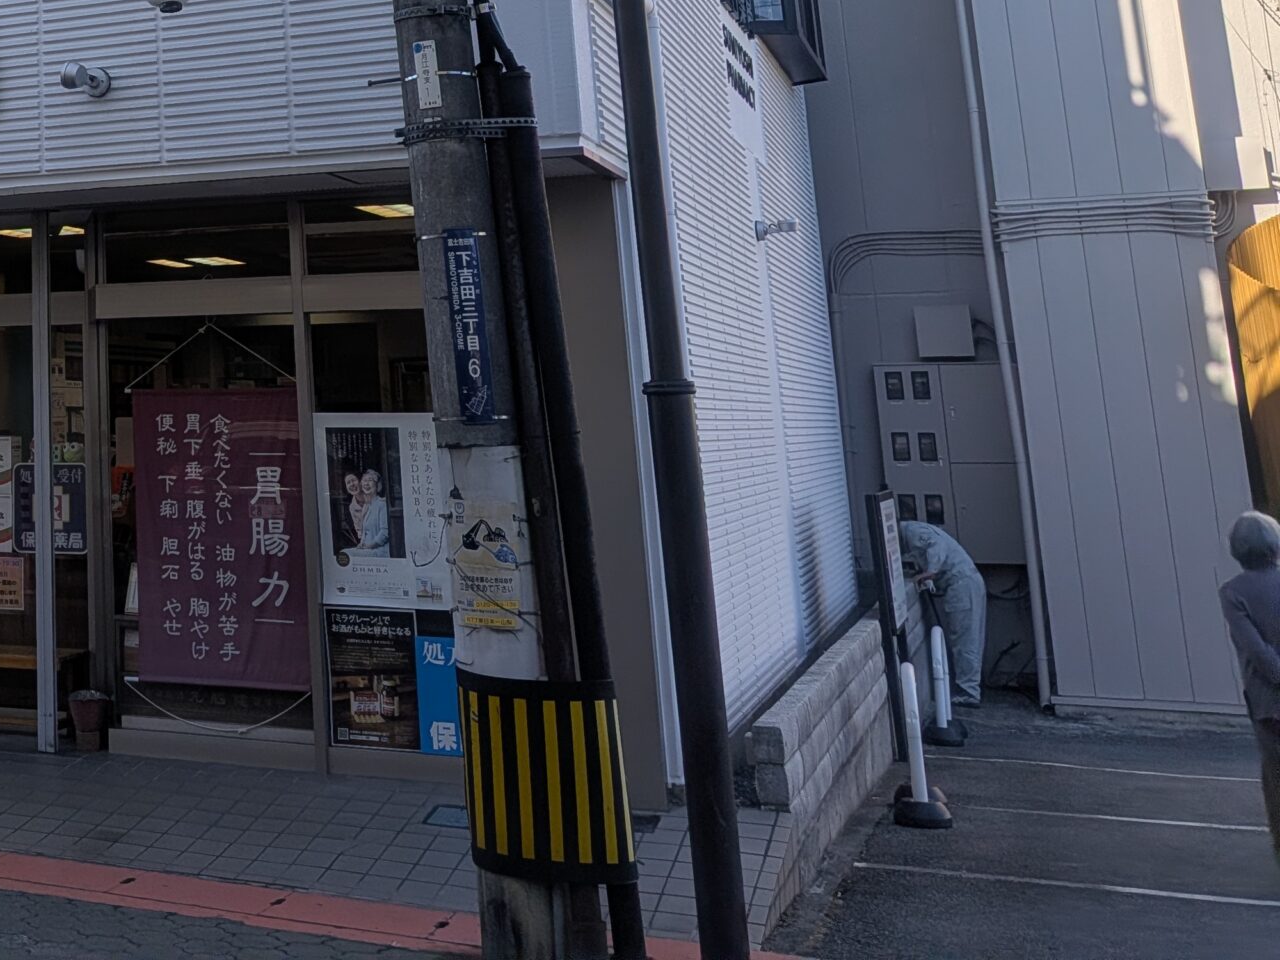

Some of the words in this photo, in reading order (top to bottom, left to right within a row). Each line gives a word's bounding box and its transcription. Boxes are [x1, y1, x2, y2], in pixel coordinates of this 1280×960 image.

[448, 251, 460, 311] SHIMOYOSHIDA
[456, 314, 465, 351] 3-CHOME
[456, 251, 480, 352] 下吉田三丁目
[468, 358, 481, 378] 6
[155, 413, 177, 455] 便秘
[183, 413, 204, 481] 胃下垂
[157, 475, 179, 519] 下痢
[210, 414, 233, 526] 食べたくない
[20, 531, 83, 549] 保薬局
[160, 537, 180, 581] 胆石
[185, 500, 207, 581] 腹がはる
[248, 466, 291, 608] 胃腸力
[162, 598, 182, 636] やせ
[188, 598, 210, 660] 胸やけ
[215, 544, 240, 662] 油物が苦手
